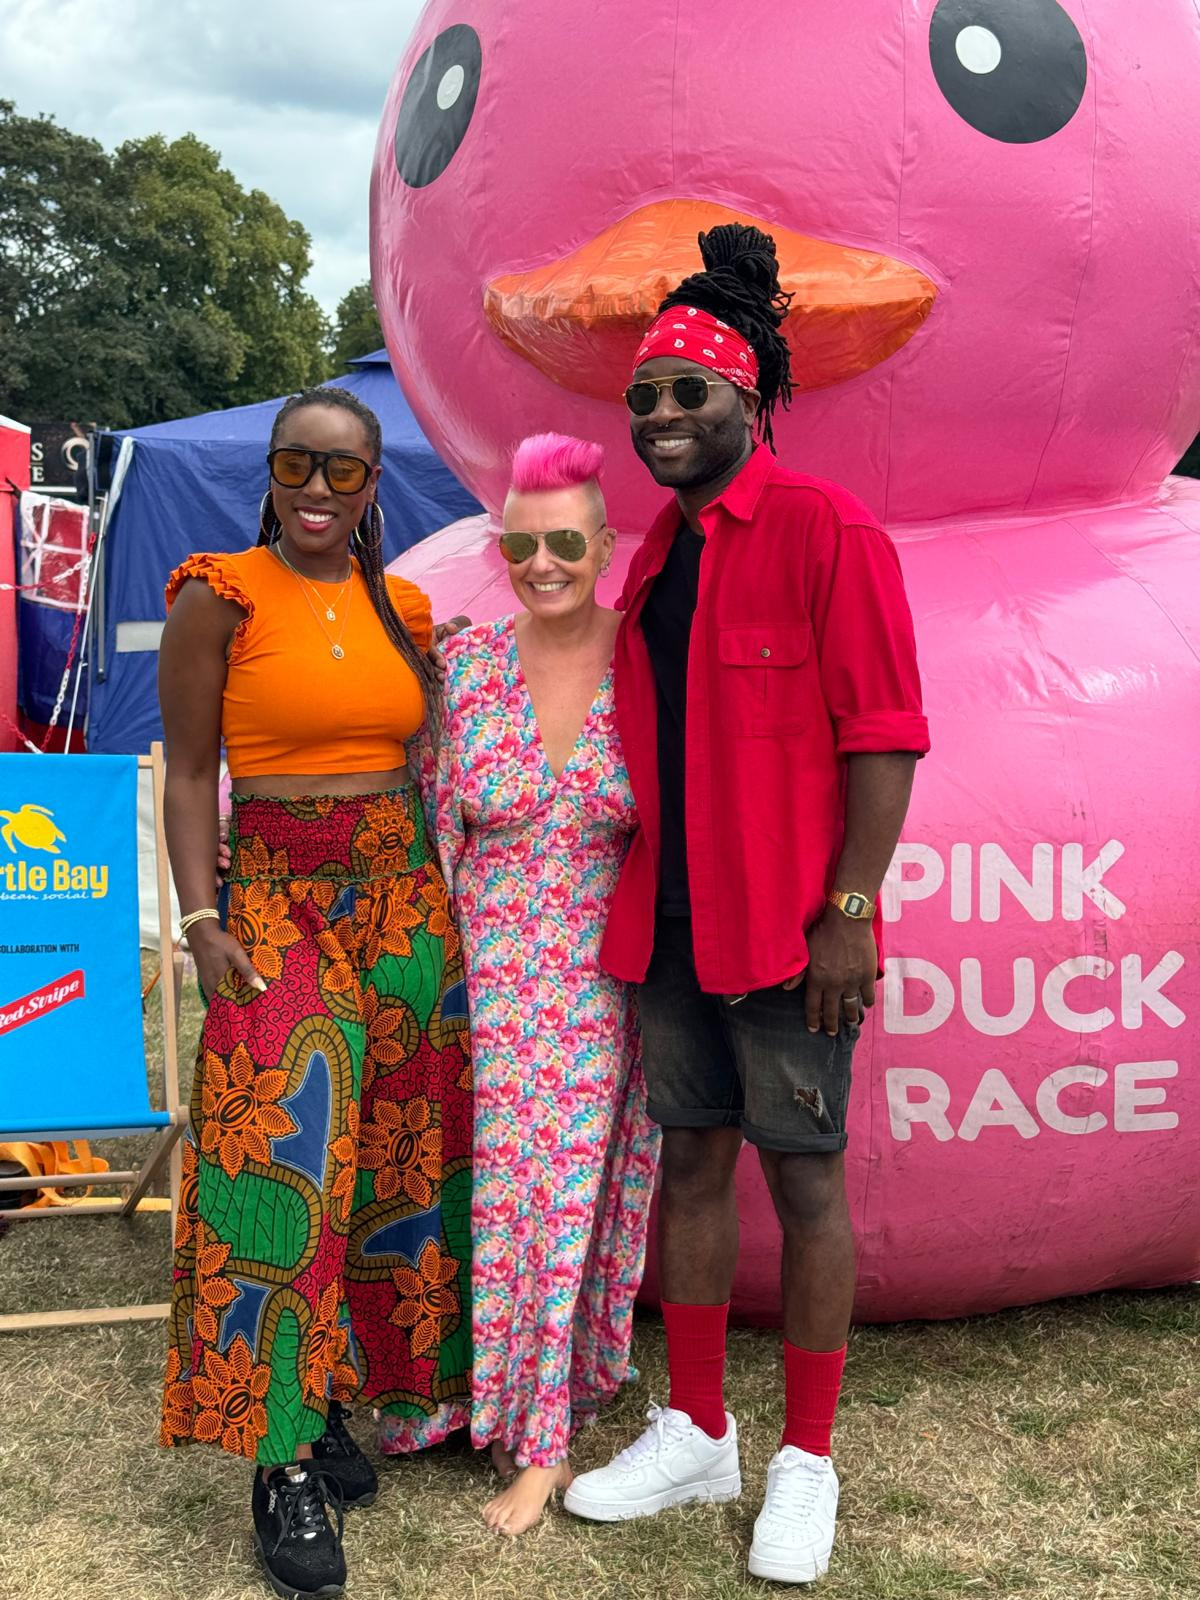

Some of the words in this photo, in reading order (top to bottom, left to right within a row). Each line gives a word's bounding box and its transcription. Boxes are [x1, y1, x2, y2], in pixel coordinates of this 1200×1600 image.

[42, 890, 91, 901] social
[53, 859, 109, 898] Bay
[880, 839, 1126, 922] PINK
[59, 943, 80, 953] WITH
[26, 979, 80, 1014] Stripe
[883, 950, 1186, 1036] DUCK
[885, 1060, 1179, 1141] RACE
